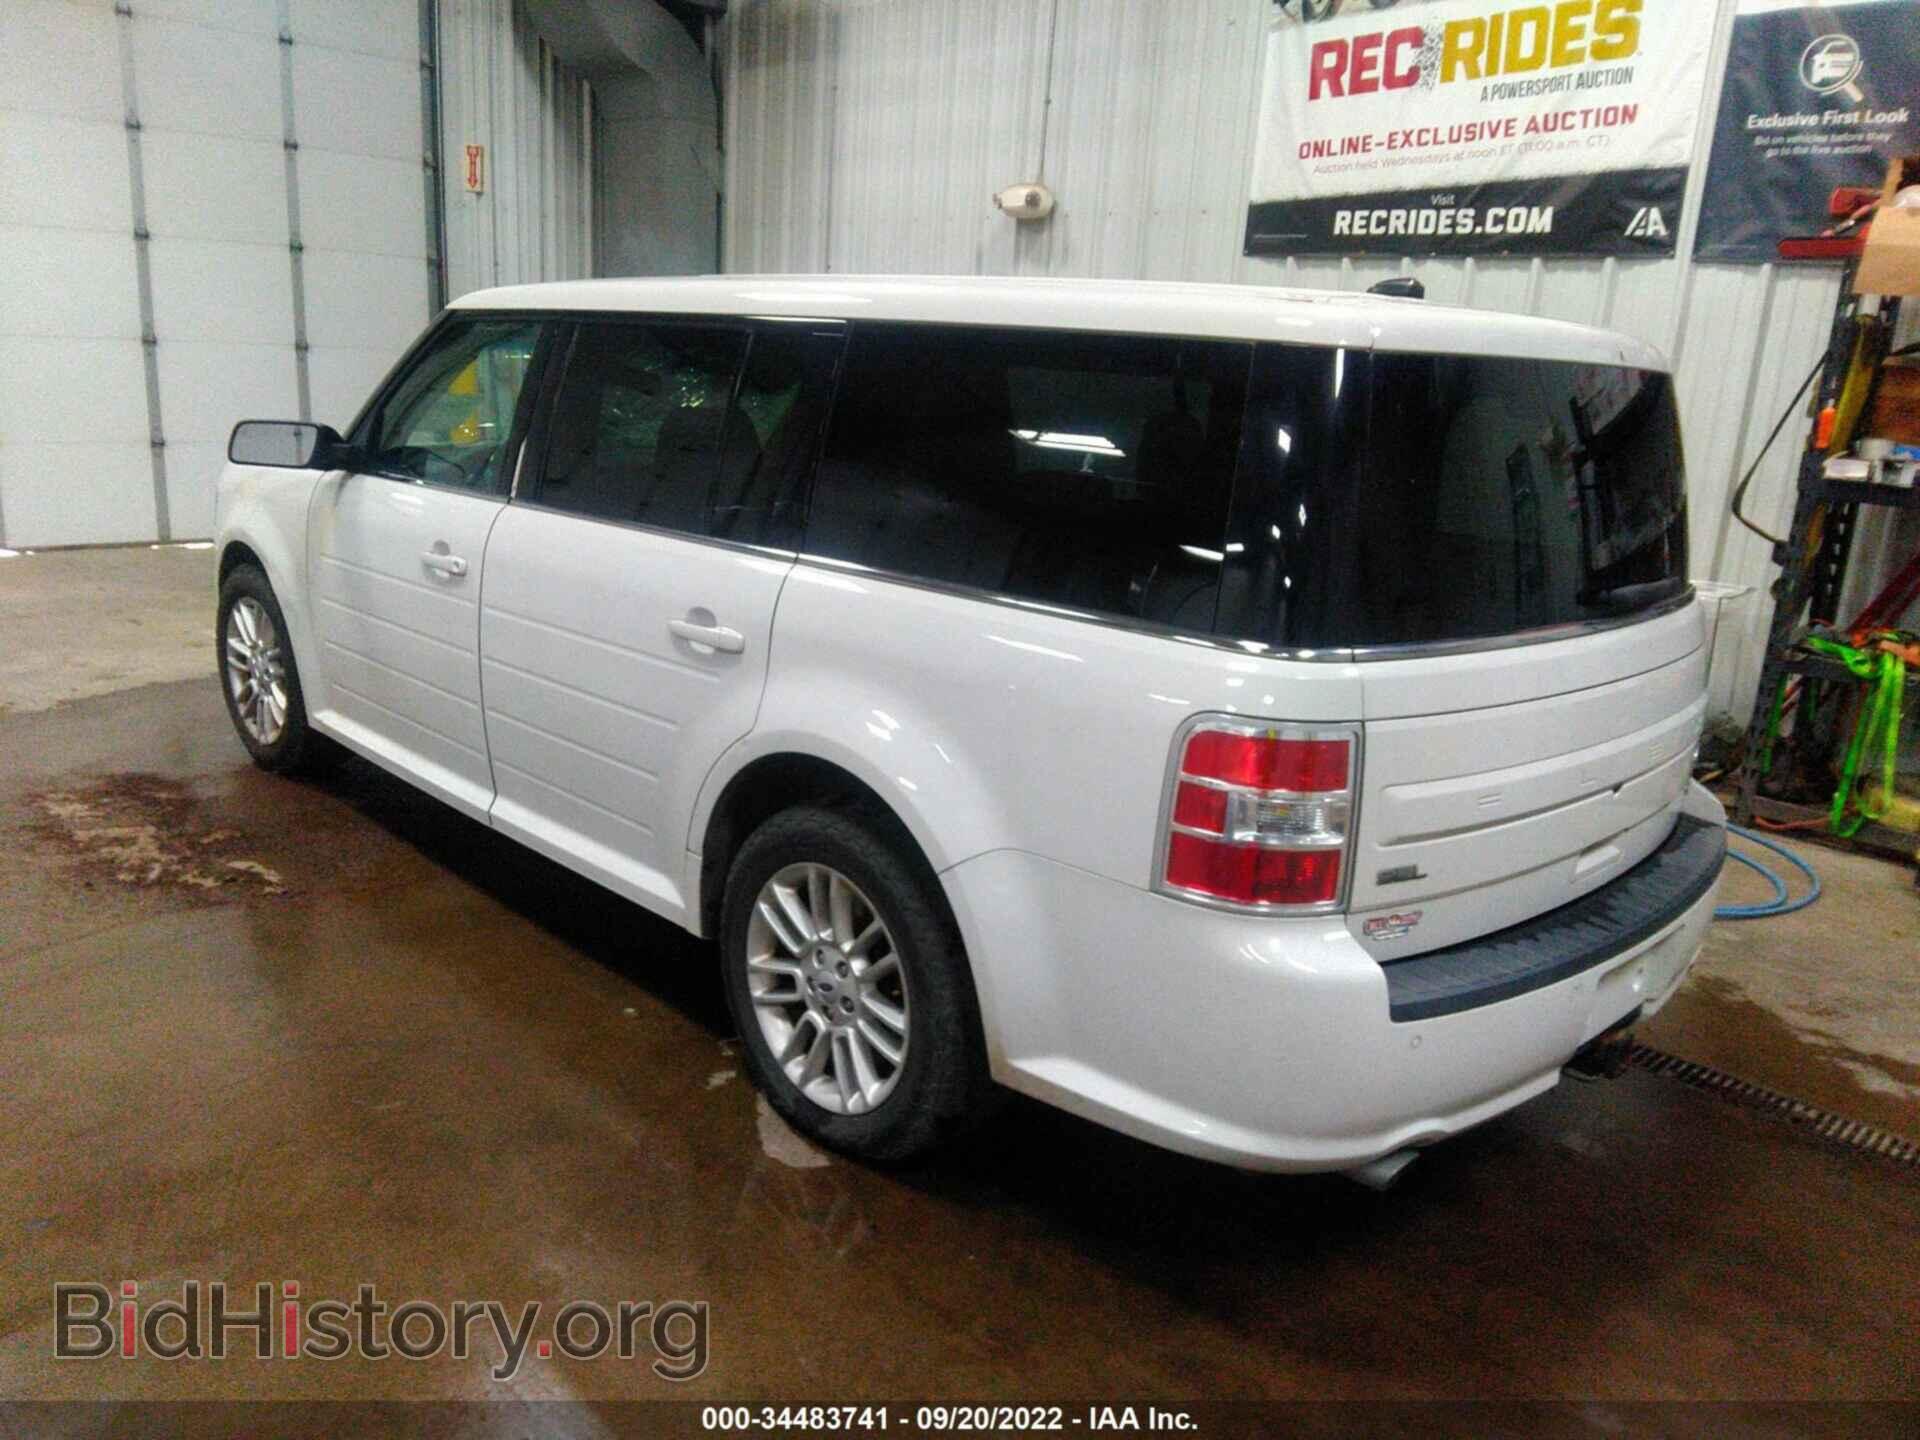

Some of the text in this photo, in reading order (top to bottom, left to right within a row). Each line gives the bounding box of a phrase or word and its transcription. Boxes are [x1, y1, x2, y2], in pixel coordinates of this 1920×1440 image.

[1308, 0, 1645, 101] REC RIDES
[1480, 66, 1635, 103] A POWERSPORT AUCTION
[1298, 103, 1639, 160] ONLINE-EXCLUSIVE AUCTION
[1747, 106, 1911, 129] Exclusive First Look
[1431, 193, 1455, 206] Visit
[1333, 205, 1555, 236] RECRIDES.COM
